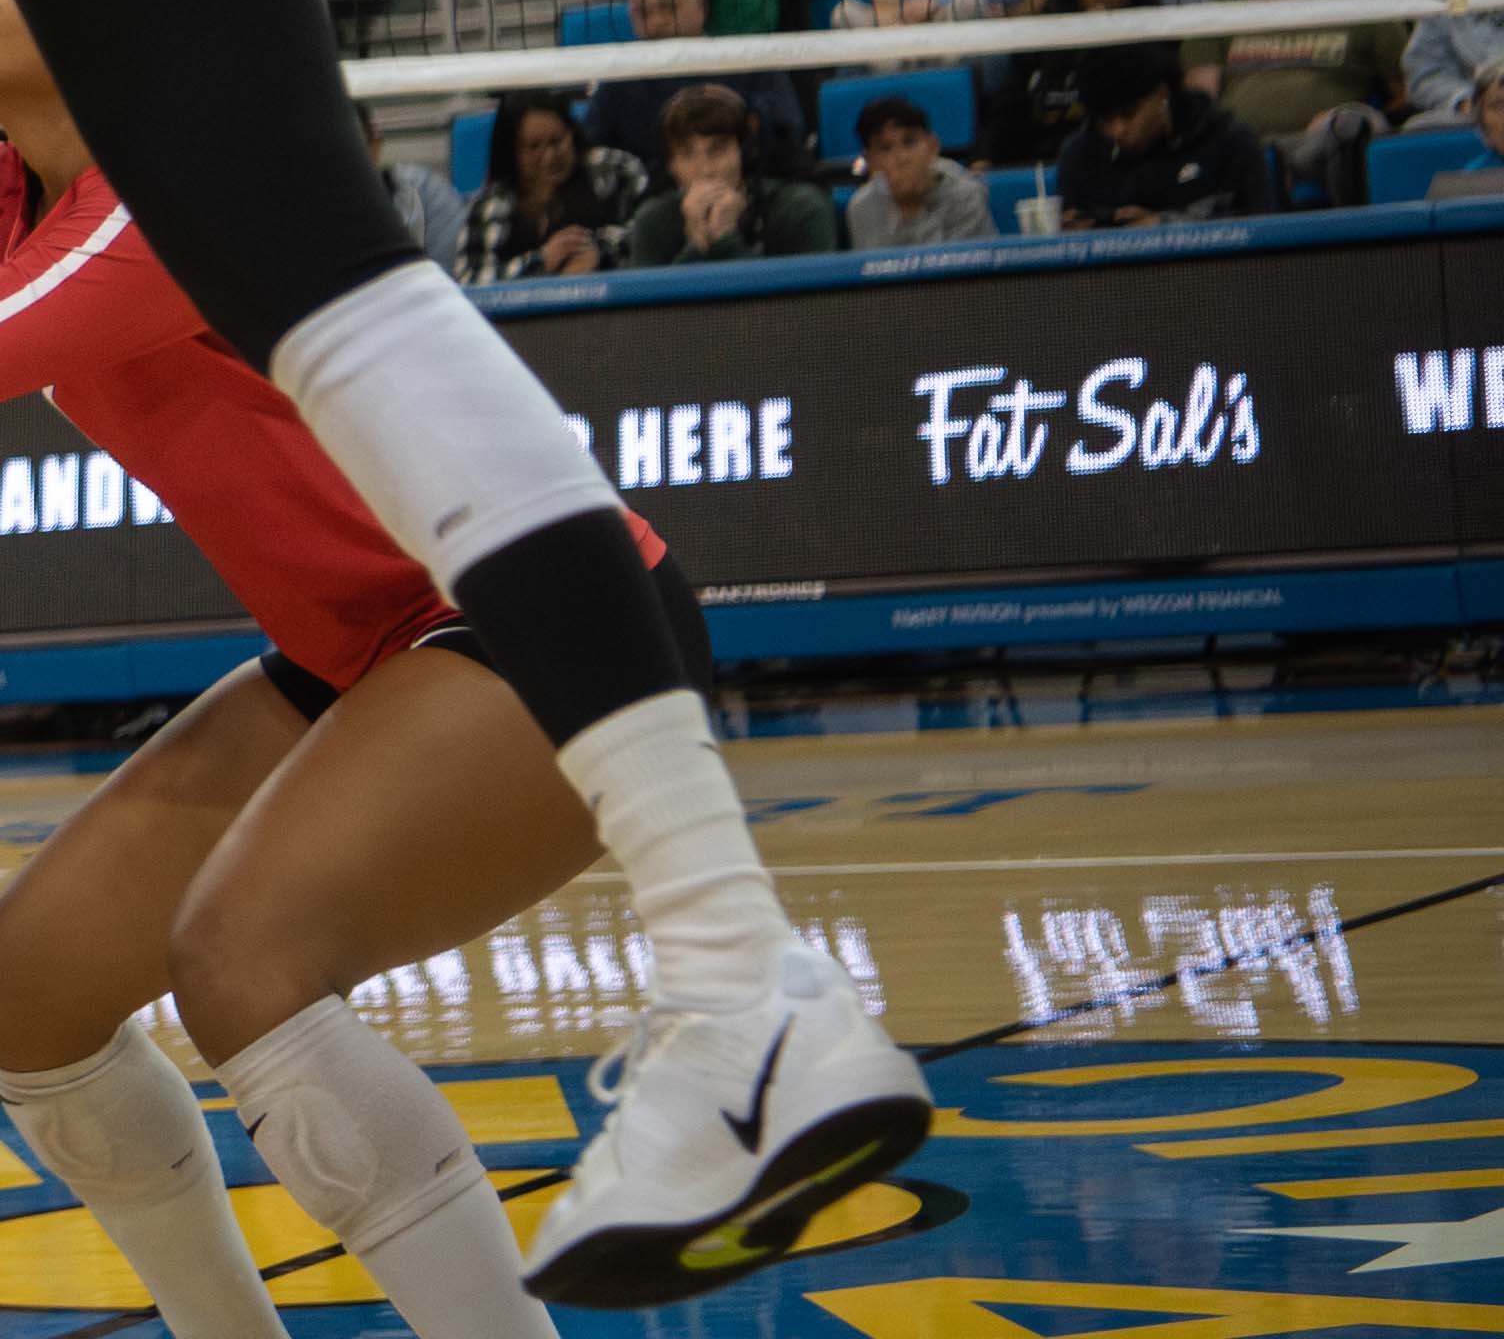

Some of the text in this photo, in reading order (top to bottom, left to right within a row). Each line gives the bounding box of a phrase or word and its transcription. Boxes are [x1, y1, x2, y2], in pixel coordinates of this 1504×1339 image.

[618, 396, 793, 491] HERE
[913, 355, 1262, 486] Fat Sal's
